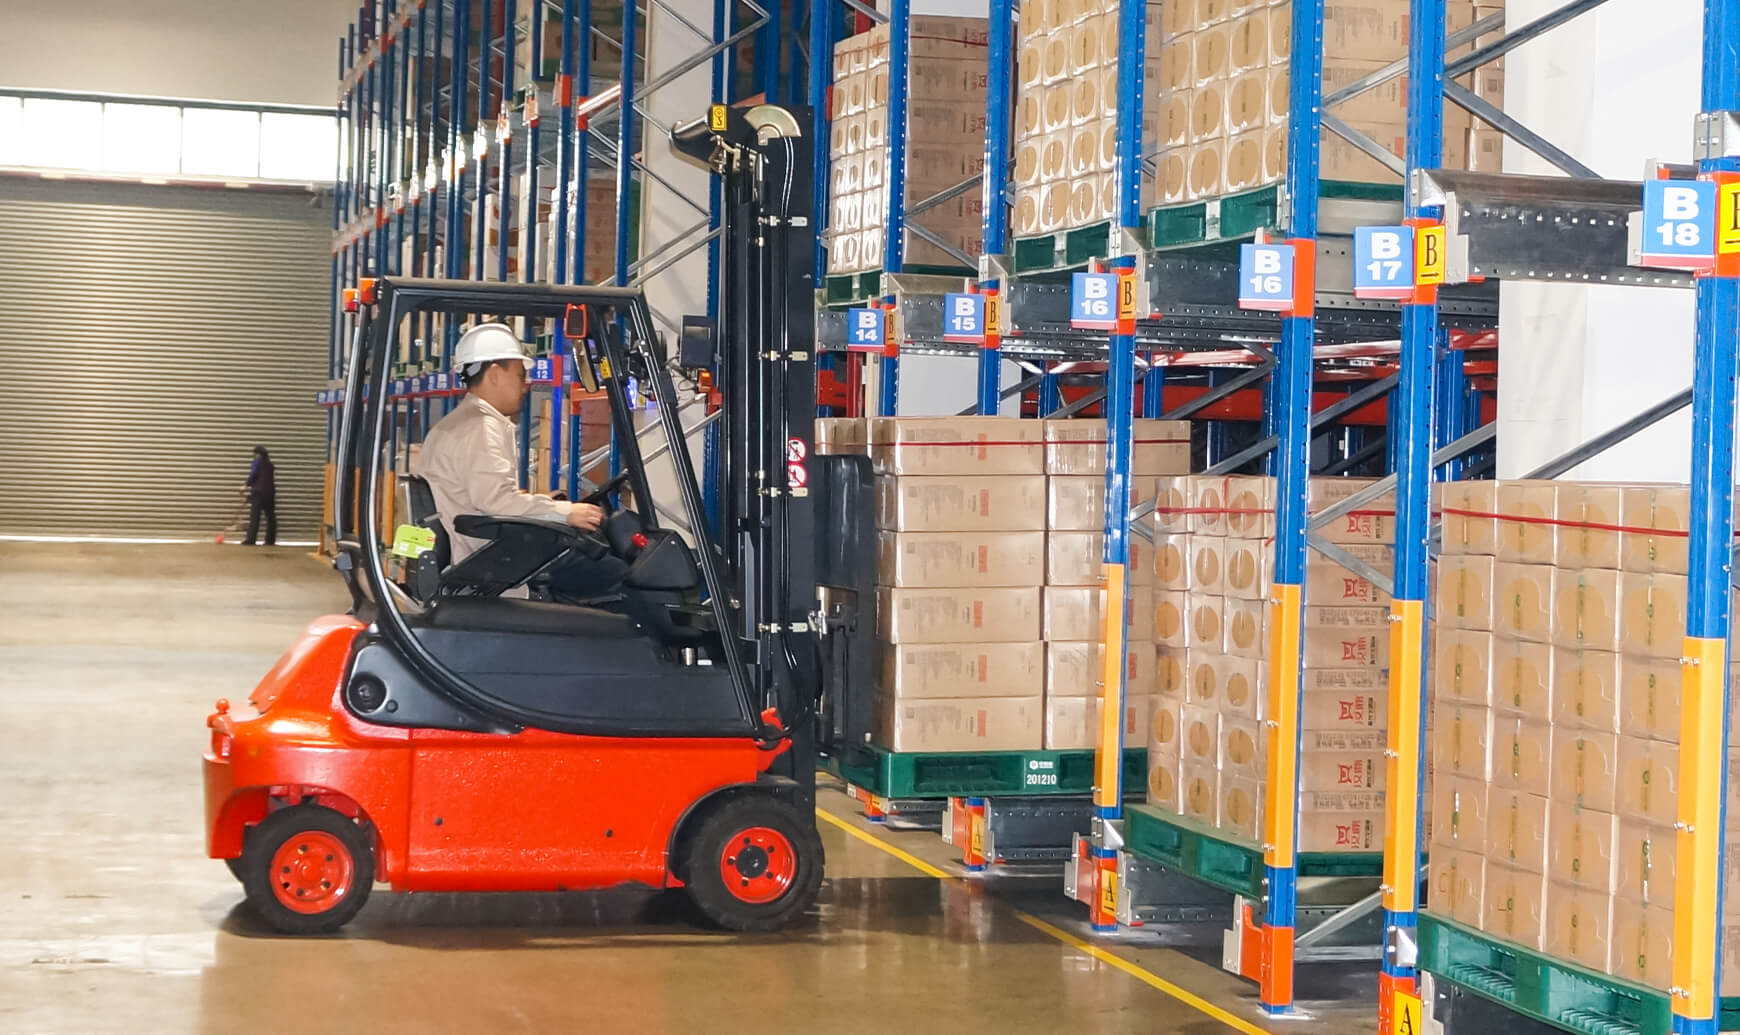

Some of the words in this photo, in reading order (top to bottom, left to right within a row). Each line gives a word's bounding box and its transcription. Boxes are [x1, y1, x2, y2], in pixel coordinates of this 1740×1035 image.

[1662, 187, 1699, 220] B
[1656, 221, 1700, 247] 18
[1371, 232, 1400, 259] B
[1424, 234, 1438, 267] B
[1254, 249, 1281, 274] B
[1367, 261, 1402, 281] 17
[1085, 277, 1108, 299] B
[1123, 280, 1132, 306] B
[1249, 275, 1283, 294] 16
[955, 297, 976, 316] B
[990, 301, 997, 323] B
[1081, 299, 1109, 315] 16
[858, 311, 877, 329] B
[951, 316, 976, 331] 15
[855, 328, 878, 342] 14
[1026, 773, 1058, 785] 201210
[1105, 874, 1114, 903] A
[1399, 1002, 1415, 1035] A
